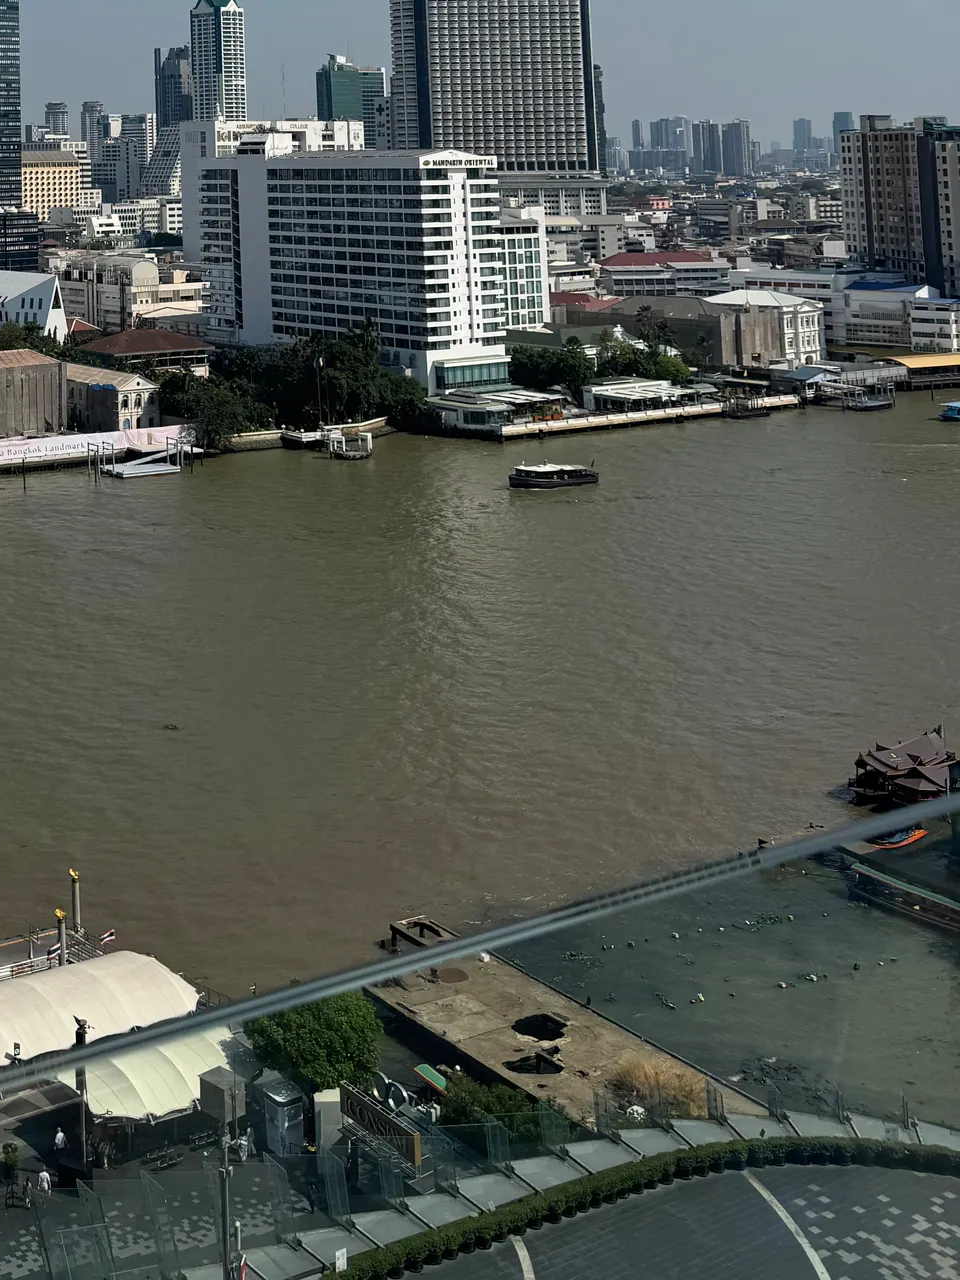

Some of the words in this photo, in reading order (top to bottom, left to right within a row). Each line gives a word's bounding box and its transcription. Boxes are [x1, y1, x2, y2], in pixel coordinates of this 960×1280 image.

[432, 159, 463, 167] MANDARIN
[464, 159, 494, 167] ORIENTAL
[7, 446, 42, 456] Bangkok
[45, 441, 86, 453] Landmark
